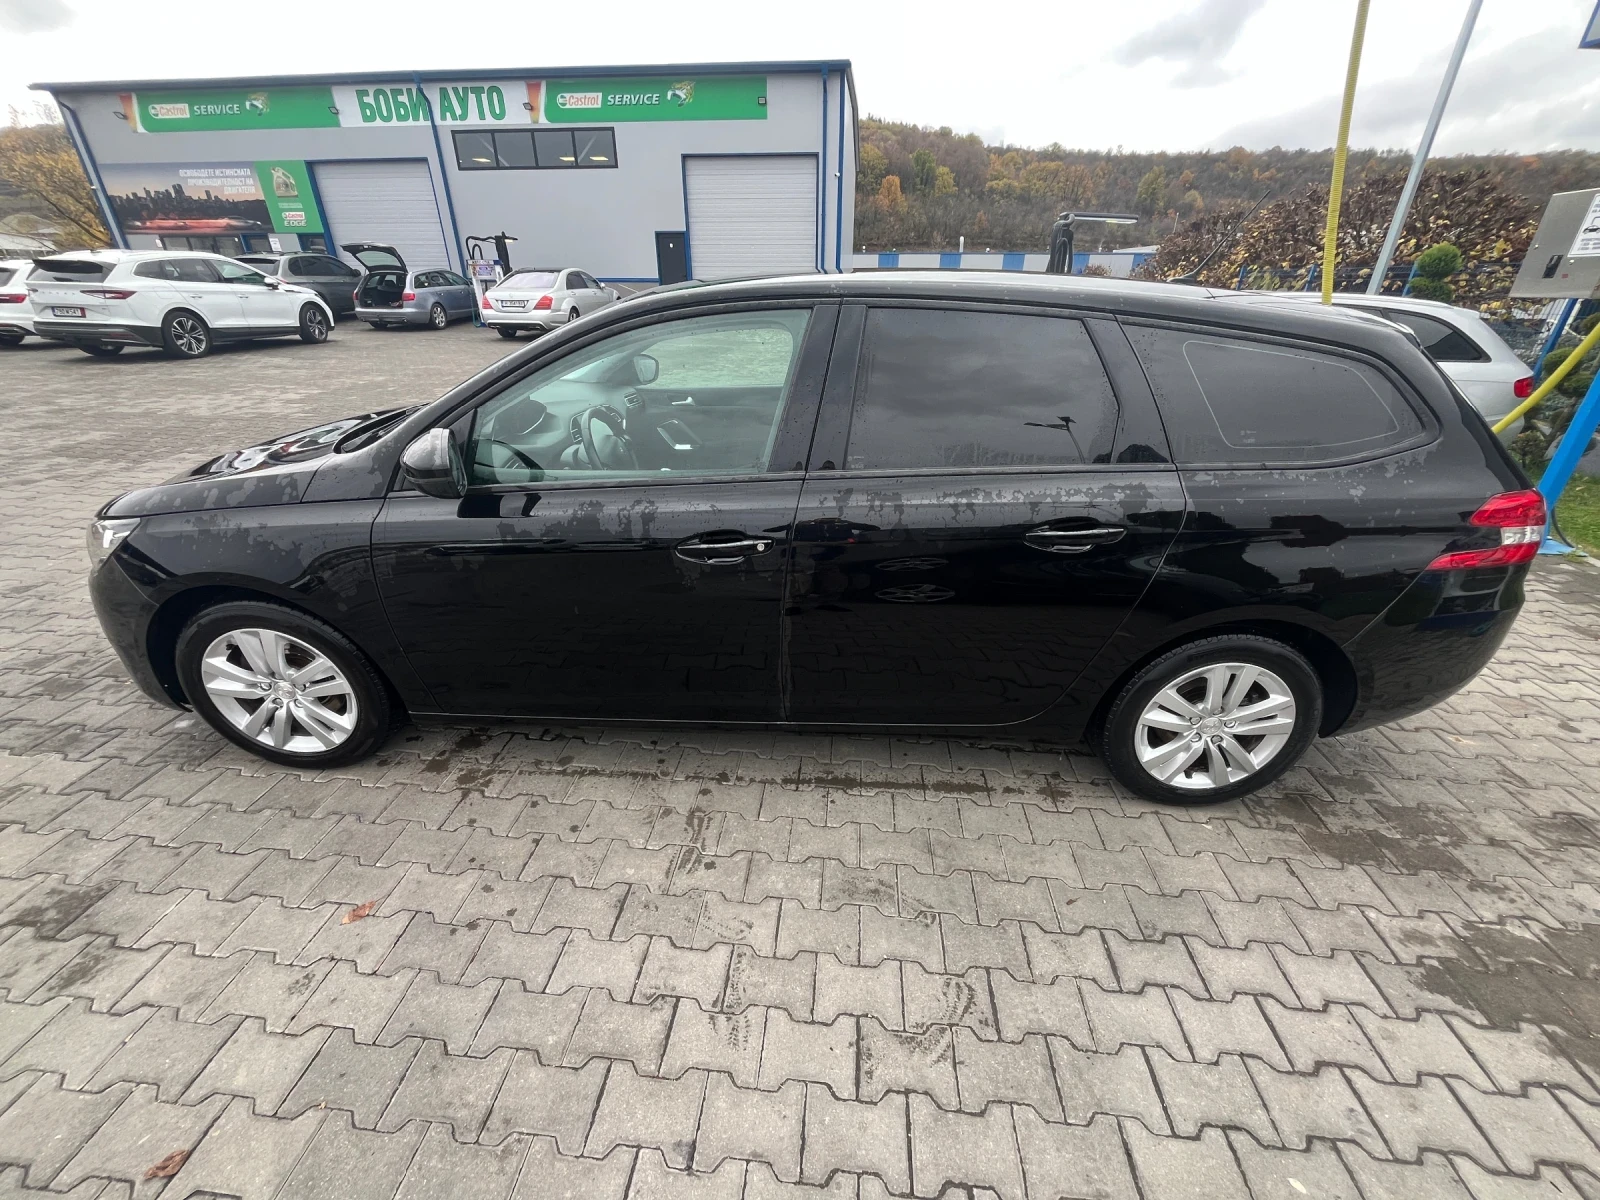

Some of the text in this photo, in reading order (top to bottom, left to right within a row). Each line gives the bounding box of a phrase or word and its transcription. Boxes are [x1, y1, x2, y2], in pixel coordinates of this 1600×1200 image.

[355, 85, 507, 123] БОБИ АУТО
[568, 93, 661, 107] Castrol SERVICE
[159, 103, 241, 117] Castrol SERVICE
